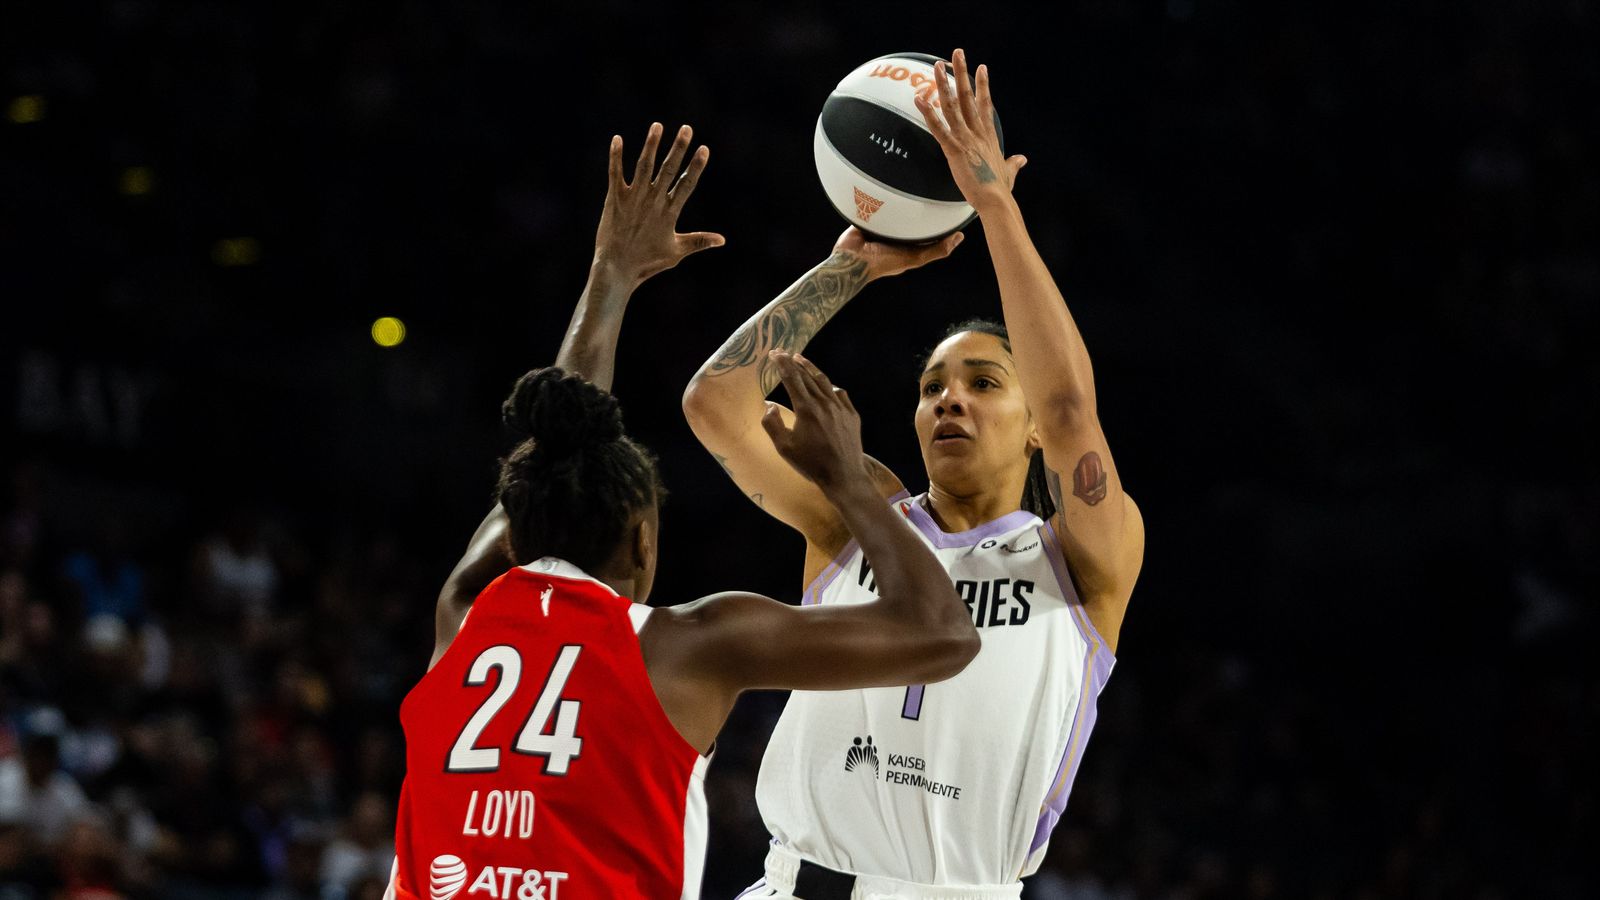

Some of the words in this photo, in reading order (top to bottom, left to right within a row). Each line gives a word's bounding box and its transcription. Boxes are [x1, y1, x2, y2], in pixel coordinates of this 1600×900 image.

[444, 643, 584, 776] 24
[888, 753, 926, 773] KAISER
[885, 770, 962, 801] PERMANENTE
[462, 789, 535, 840] LOYD
[467, 866, 569, 900] AT&T
